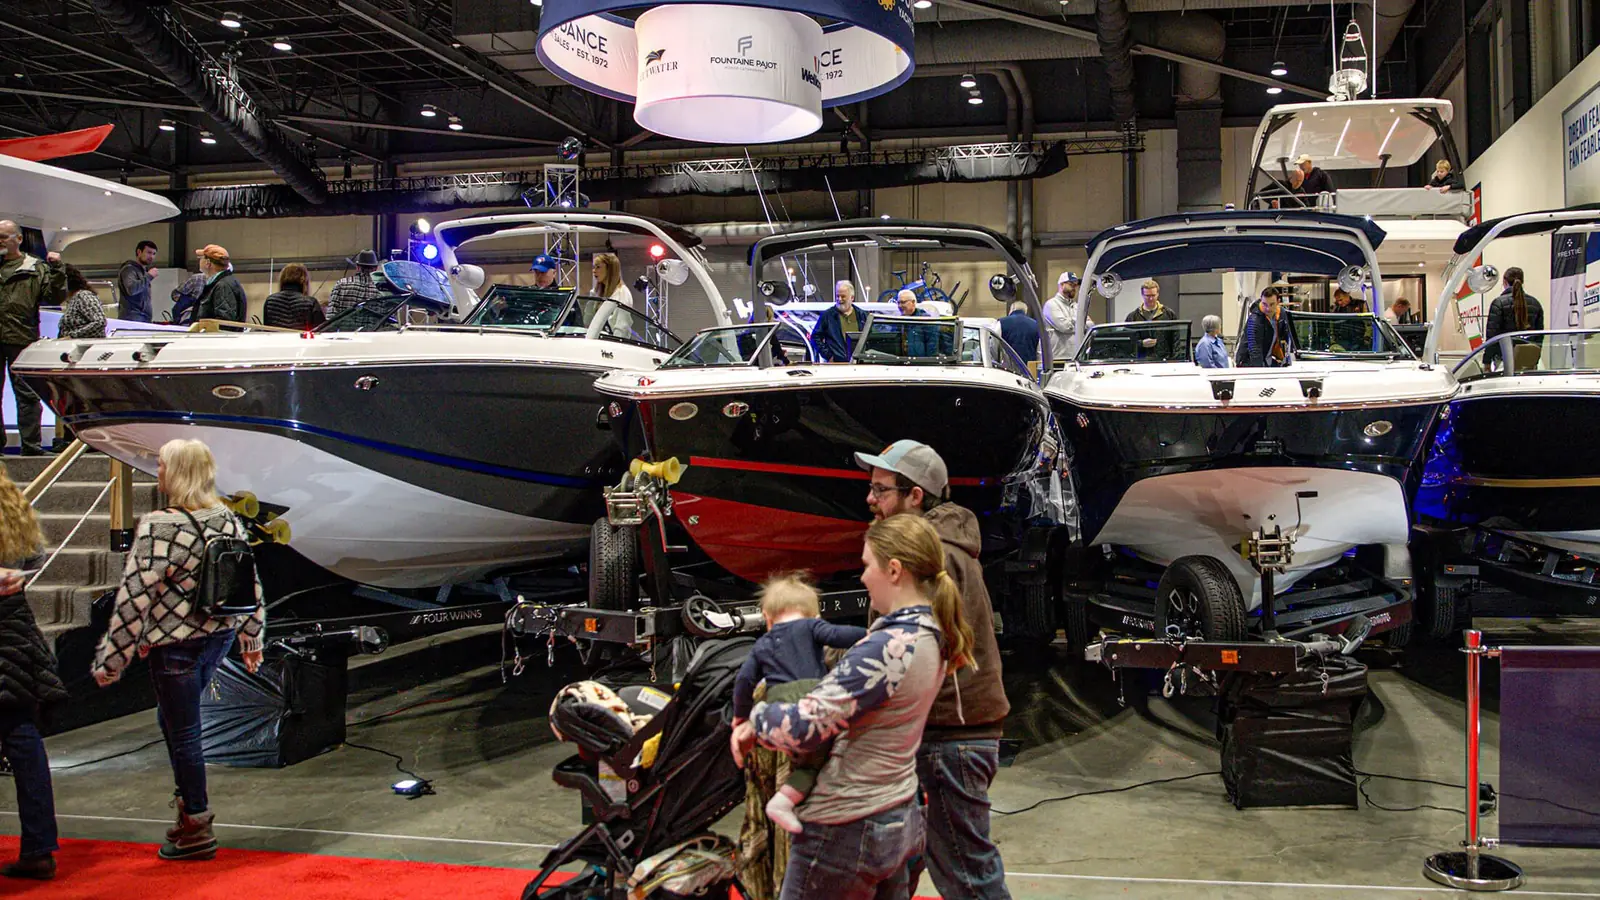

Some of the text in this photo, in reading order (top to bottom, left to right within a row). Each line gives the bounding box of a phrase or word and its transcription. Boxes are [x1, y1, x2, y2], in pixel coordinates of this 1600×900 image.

[554, 33, 608, 68] SALES EST. 1972
[640, 61, 679, 81] TWATER
[710, 56, 755, 67] FOUNTAINE
[756, 60, 778, 70] PAJOT
[826, 70, 843, 80] 1972
[1568, 113, 1588, 147] DREAM
[1569, 144, 1580, 171] FAN
[1460, 305, 1481, 327] TOYOTA
[423, 609, 483, 624] FOUR WINNS
